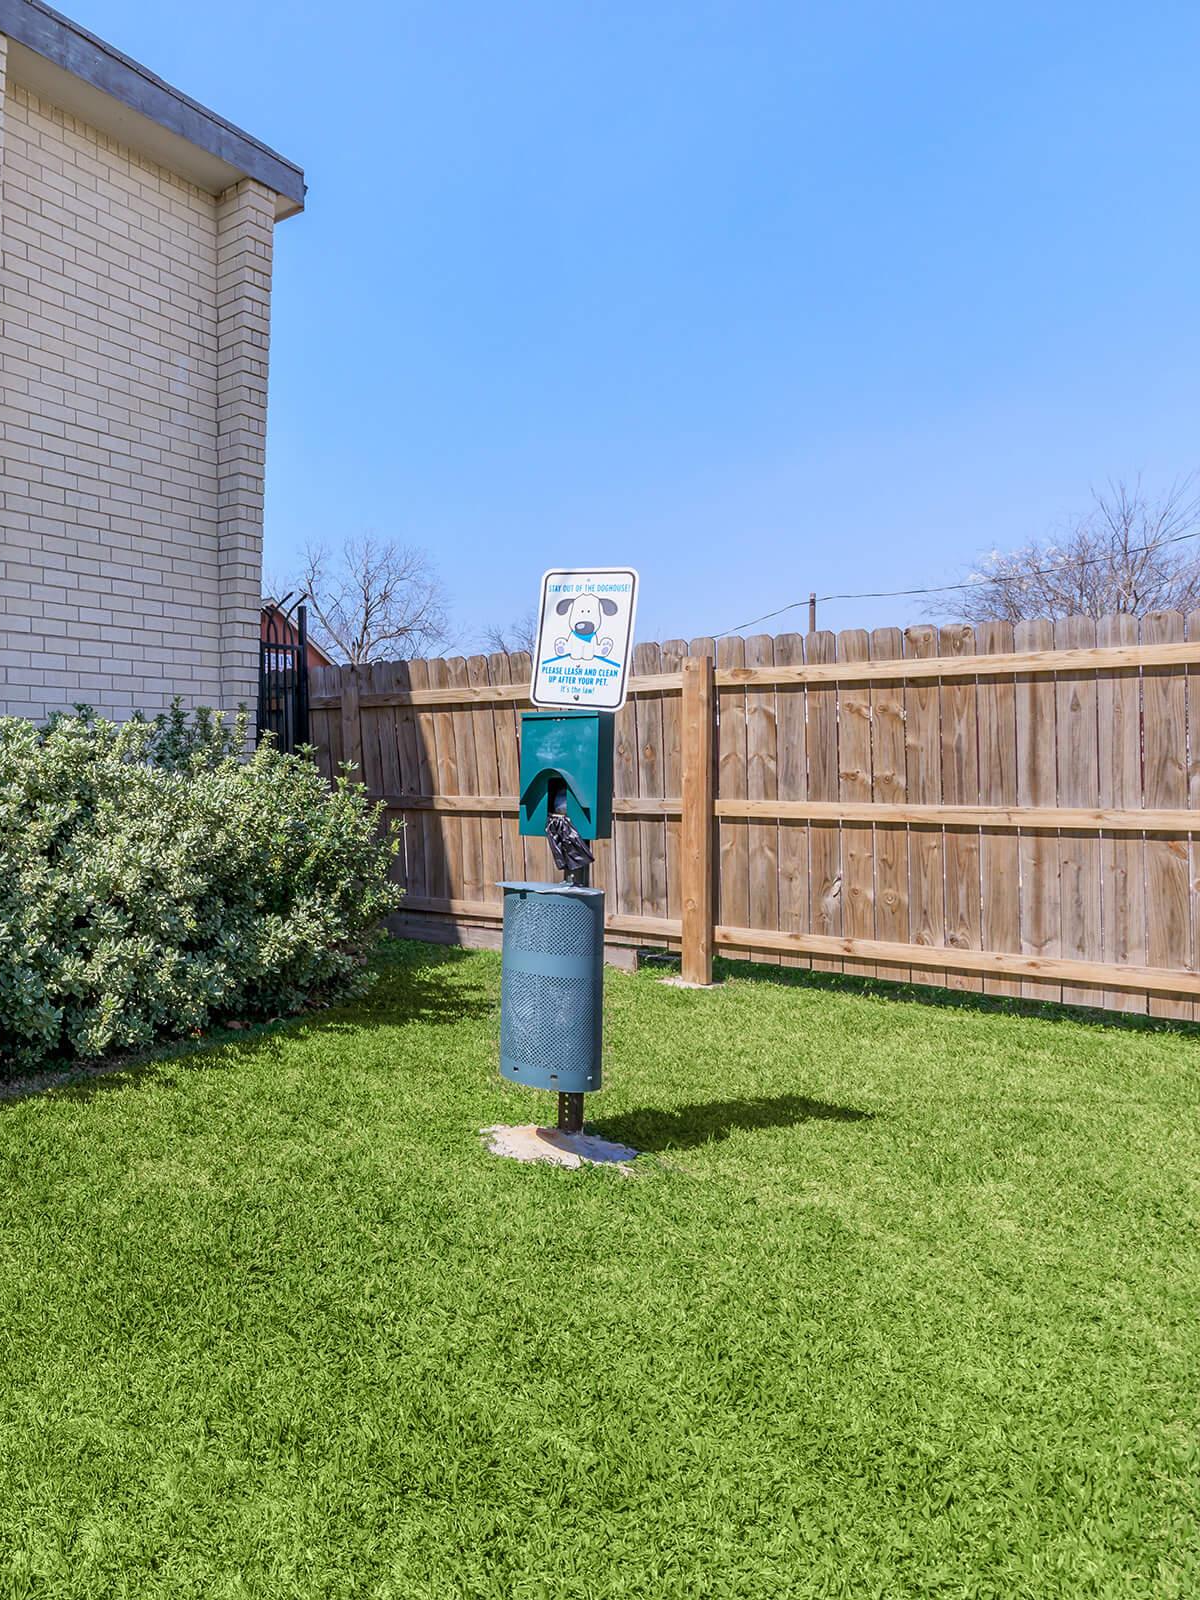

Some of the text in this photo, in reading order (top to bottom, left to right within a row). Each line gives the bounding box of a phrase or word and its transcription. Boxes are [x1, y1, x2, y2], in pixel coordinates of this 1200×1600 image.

[548, 583, 630, 592] STAY OUT OF THE DOGHOUSE!
[542, 666, 618, 678] PLEASE LEASH AND CLEAN
[558, 676, 576, 684] AFTER
[578, 677, 594, 685] YOUR
[595, 678, 608, 687] PET.
[571, 686, 580, 694] the
